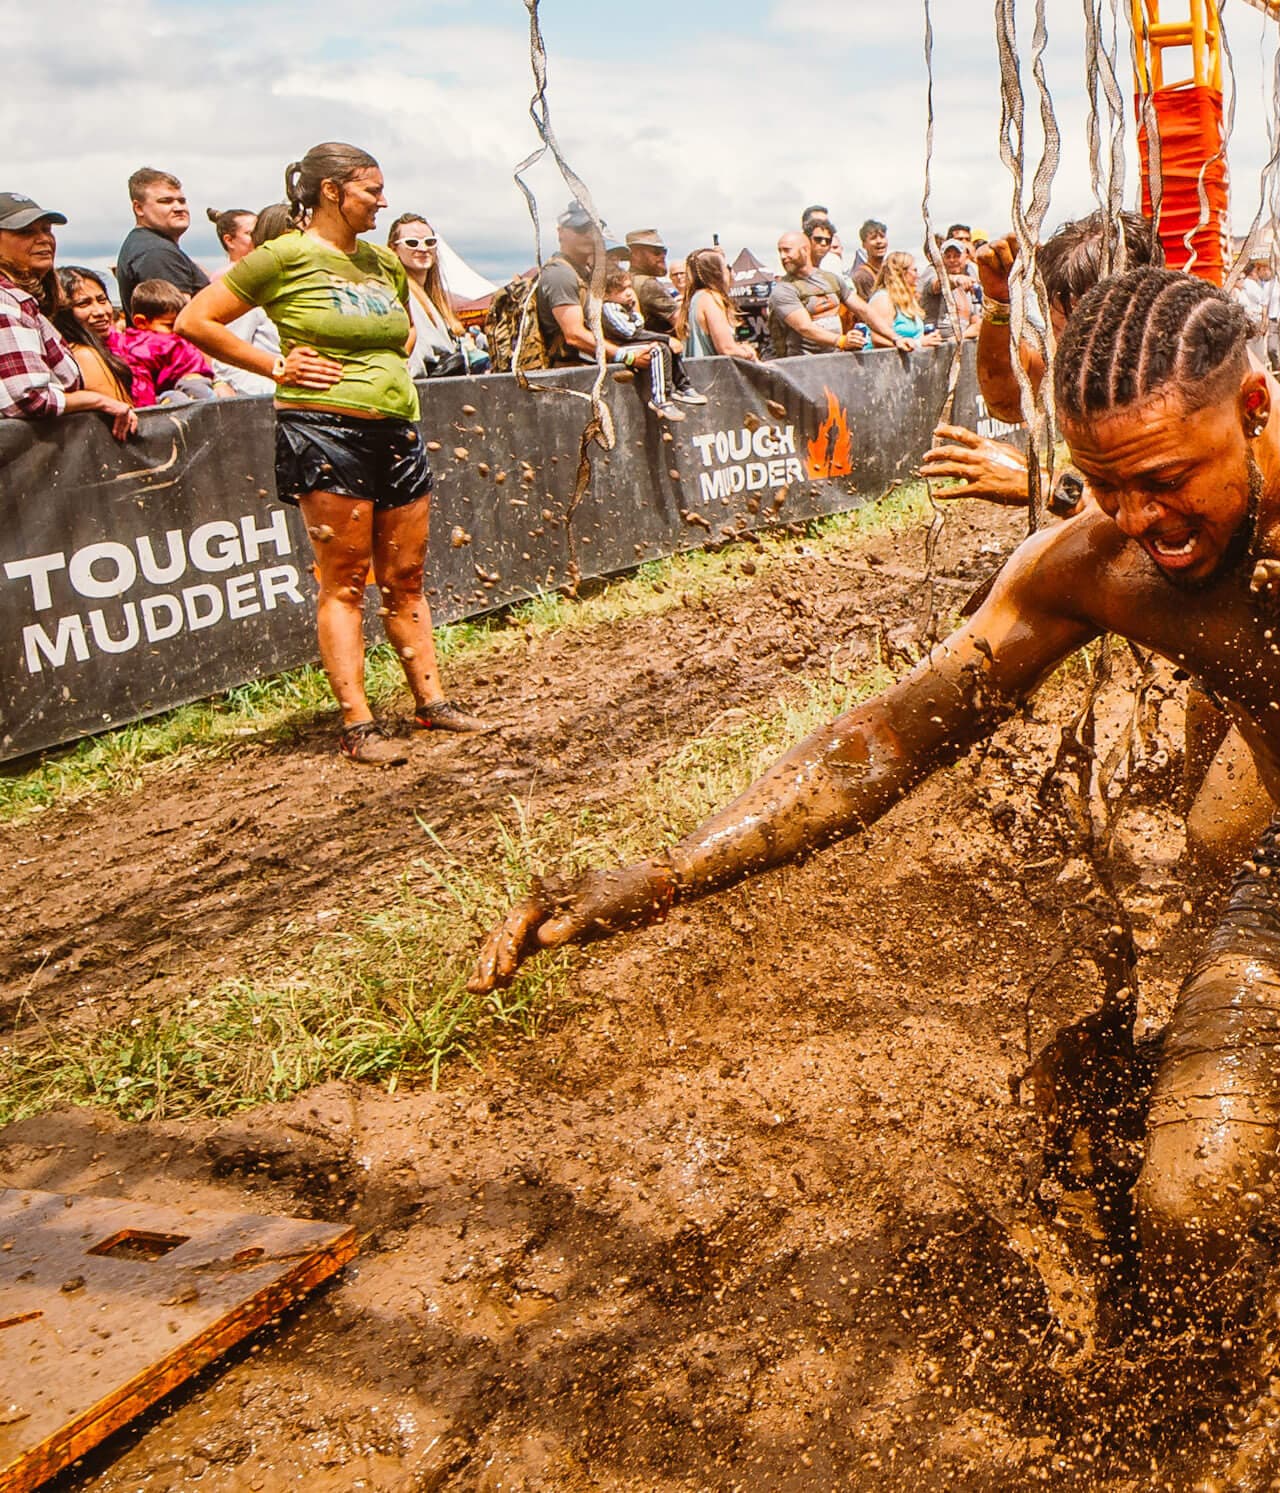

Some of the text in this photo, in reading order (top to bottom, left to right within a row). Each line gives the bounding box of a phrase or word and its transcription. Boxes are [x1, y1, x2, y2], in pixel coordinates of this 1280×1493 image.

[692, 425, 796, 467] TOUGH
[3, 509, 292, 612] TOUGH
[22, 564, 306, 674] MUDDER
